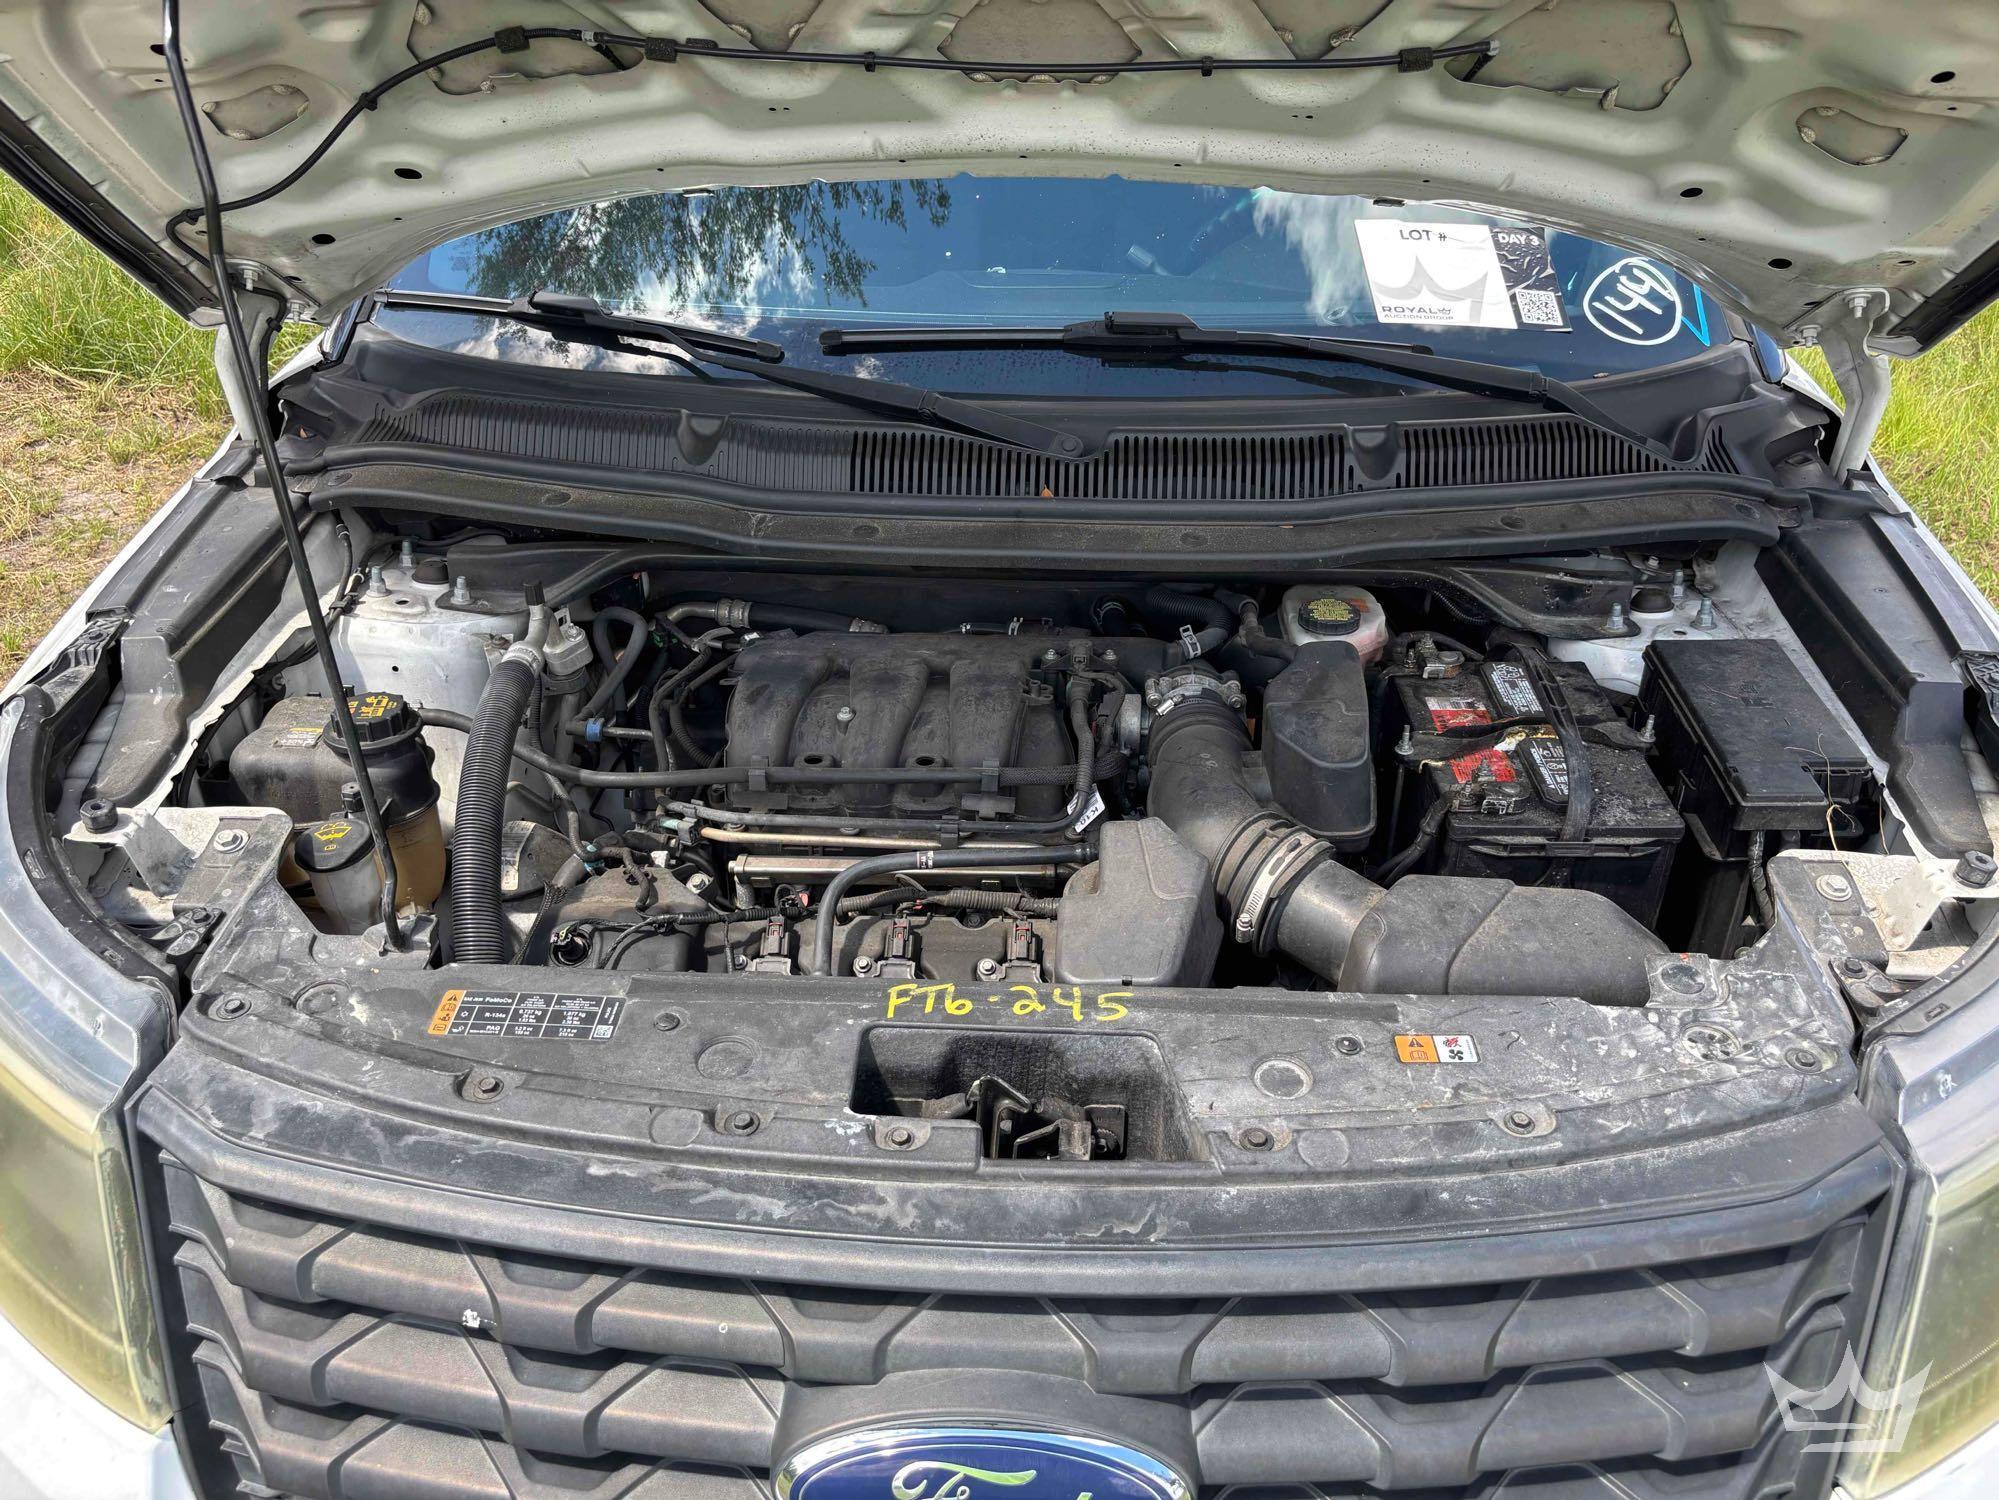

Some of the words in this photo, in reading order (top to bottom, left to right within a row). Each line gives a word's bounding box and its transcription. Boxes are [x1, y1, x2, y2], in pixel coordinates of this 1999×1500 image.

[1399, 229, 1432, 241] LOT
[1438, 232, 1447, 242] #
[1497, 233, 1528, 245] DAY
[1529, 234, 1540, 246] 3
[1592, 268, 1675, 335] 144
[1381, 305, 1438, 315] ROYAL
